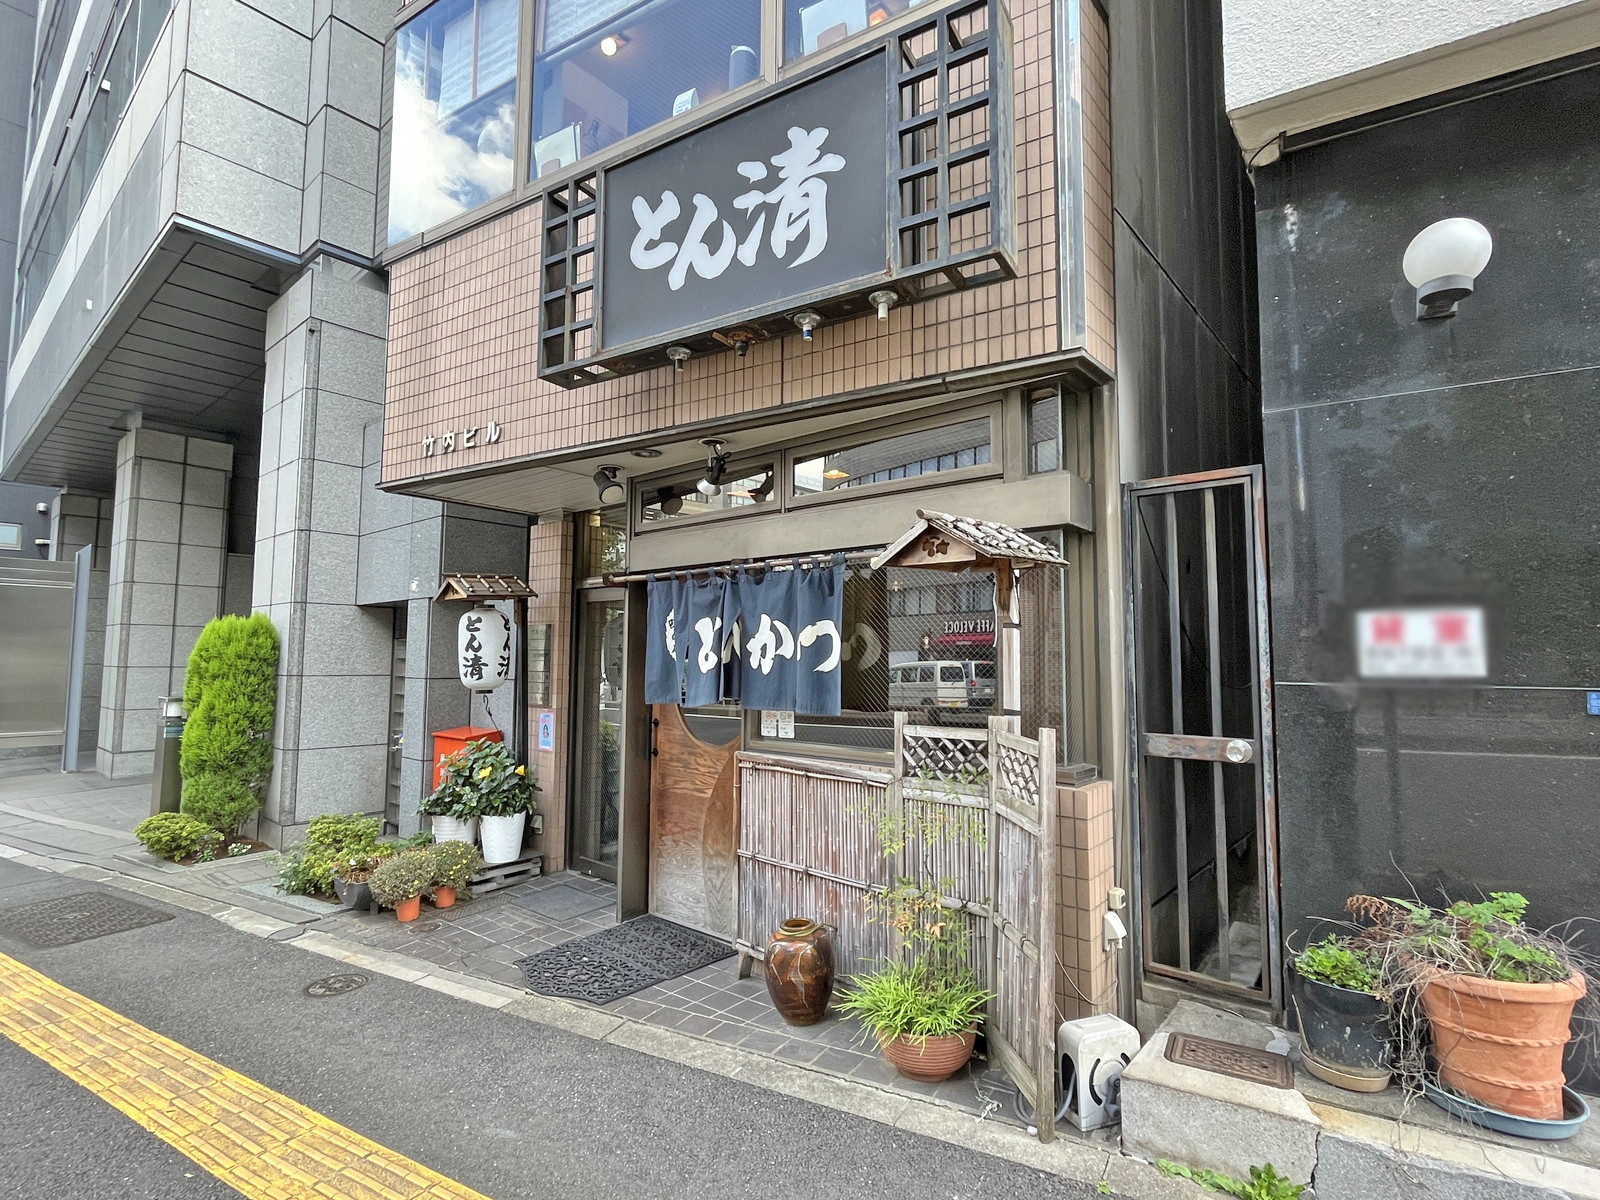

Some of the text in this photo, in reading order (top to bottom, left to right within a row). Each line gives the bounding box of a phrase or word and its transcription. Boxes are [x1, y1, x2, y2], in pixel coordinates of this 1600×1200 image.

[630, 126, 846, 291] とん清
[421, 420, 500, 458] 竹内ビル
[462, 615, 489, 681] とん清
